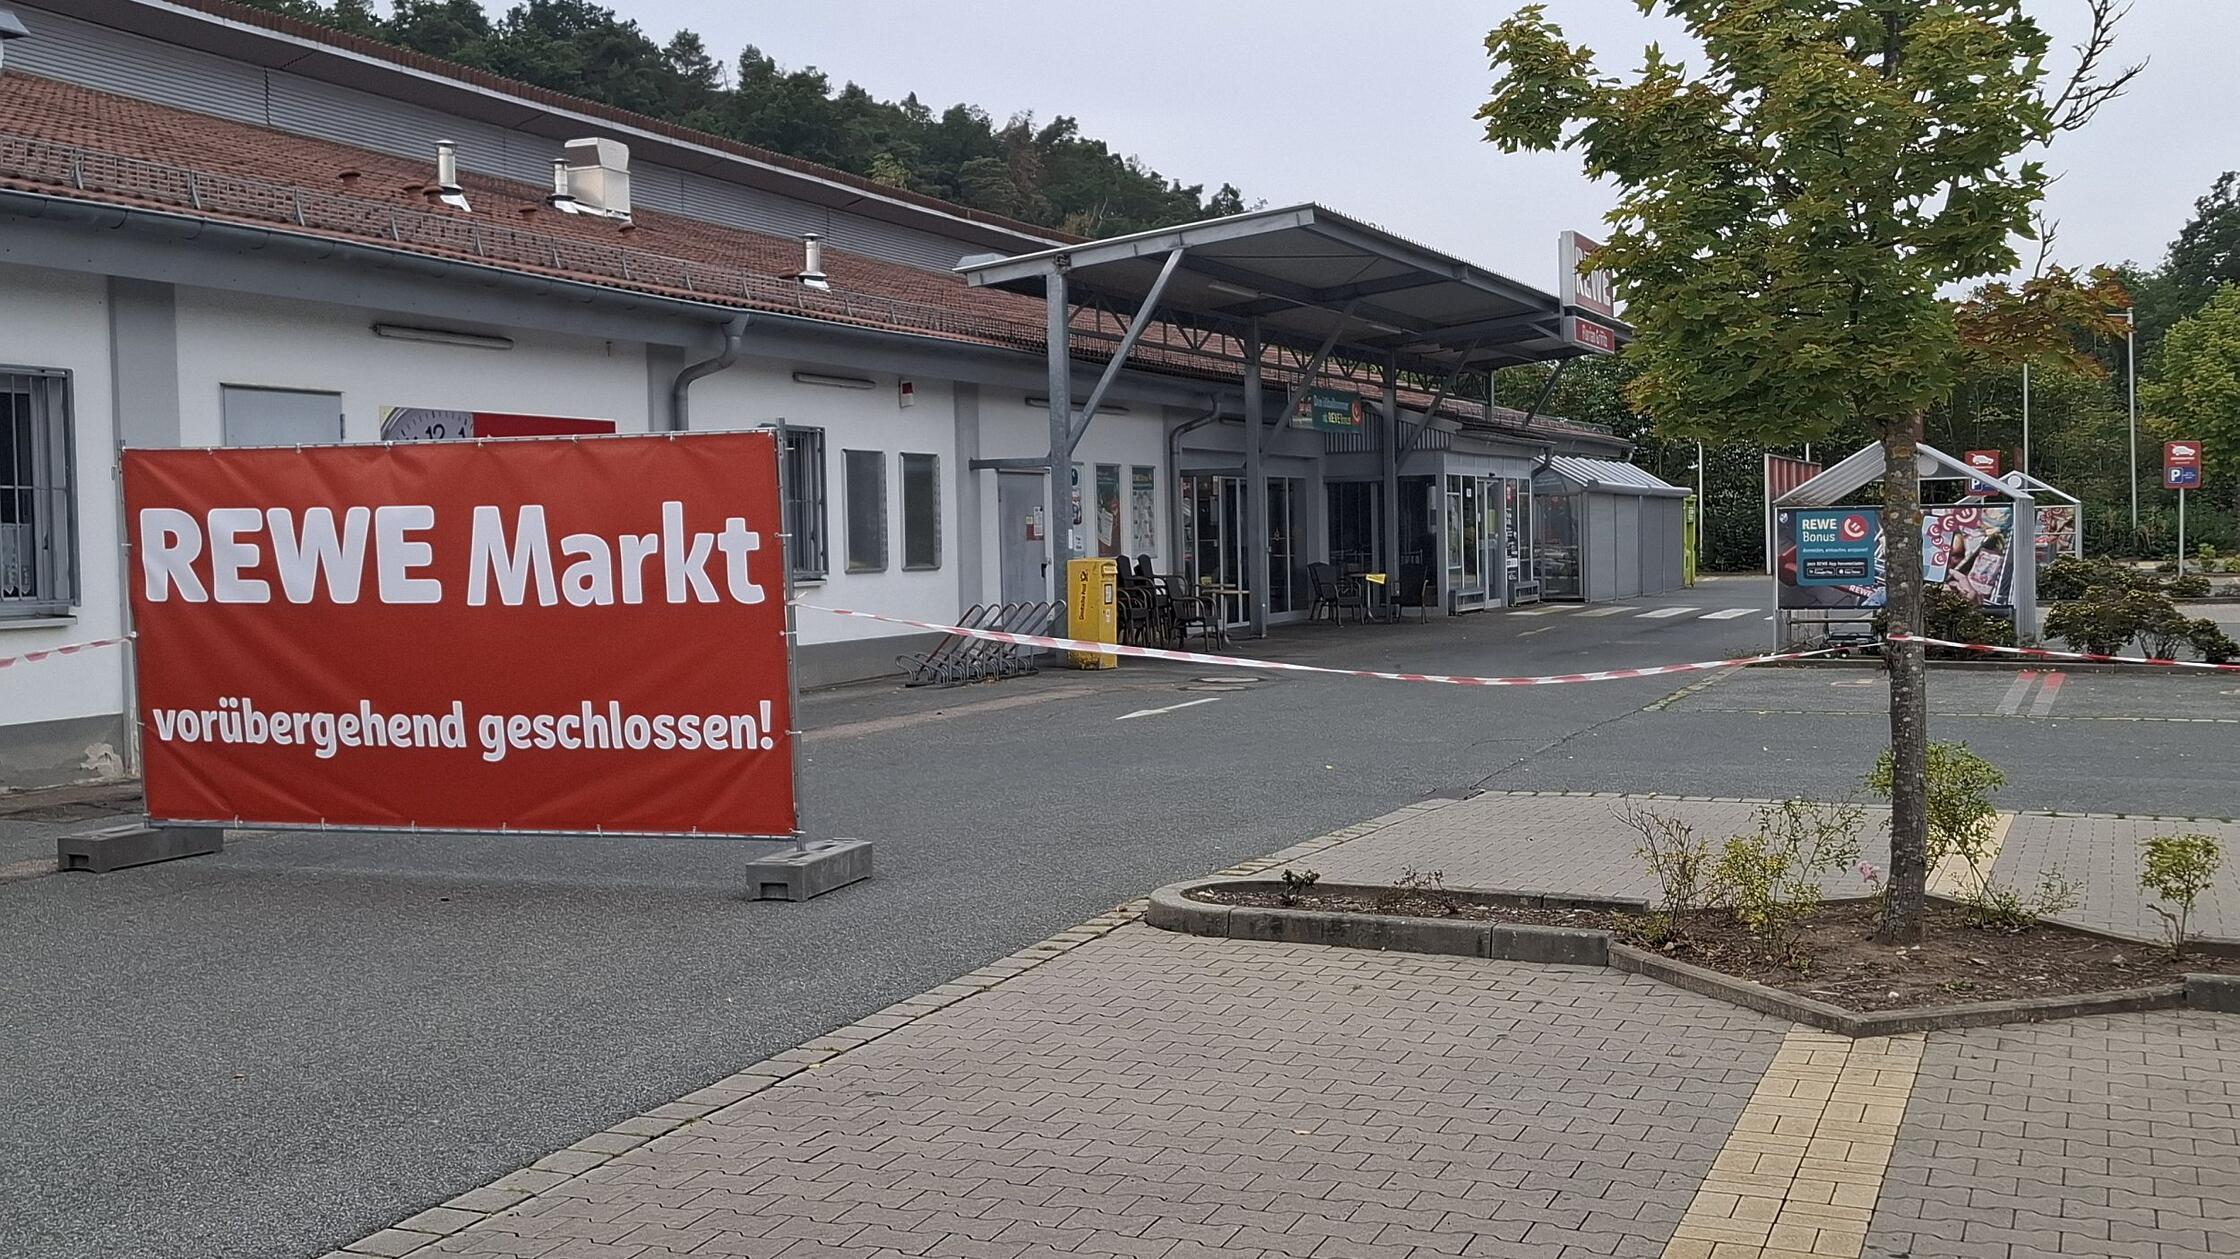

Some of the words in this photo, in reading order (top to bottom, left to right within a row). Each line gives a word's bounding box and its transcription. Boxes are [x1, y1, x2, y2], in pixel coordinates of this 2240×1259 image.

[2171, 469, 2181, 481] P
[1971, 479, 1981, 490] P
[1802, 518, 1837, 530] REWE
[1802, 531, 1836, 542] Bonus
[140, 506, 442, 604] REWE
[467, 501, 765, 607] Markt
[153, 697, 466, 759] vorübergehend
[478, 699, 774, 762] geschlossen!
